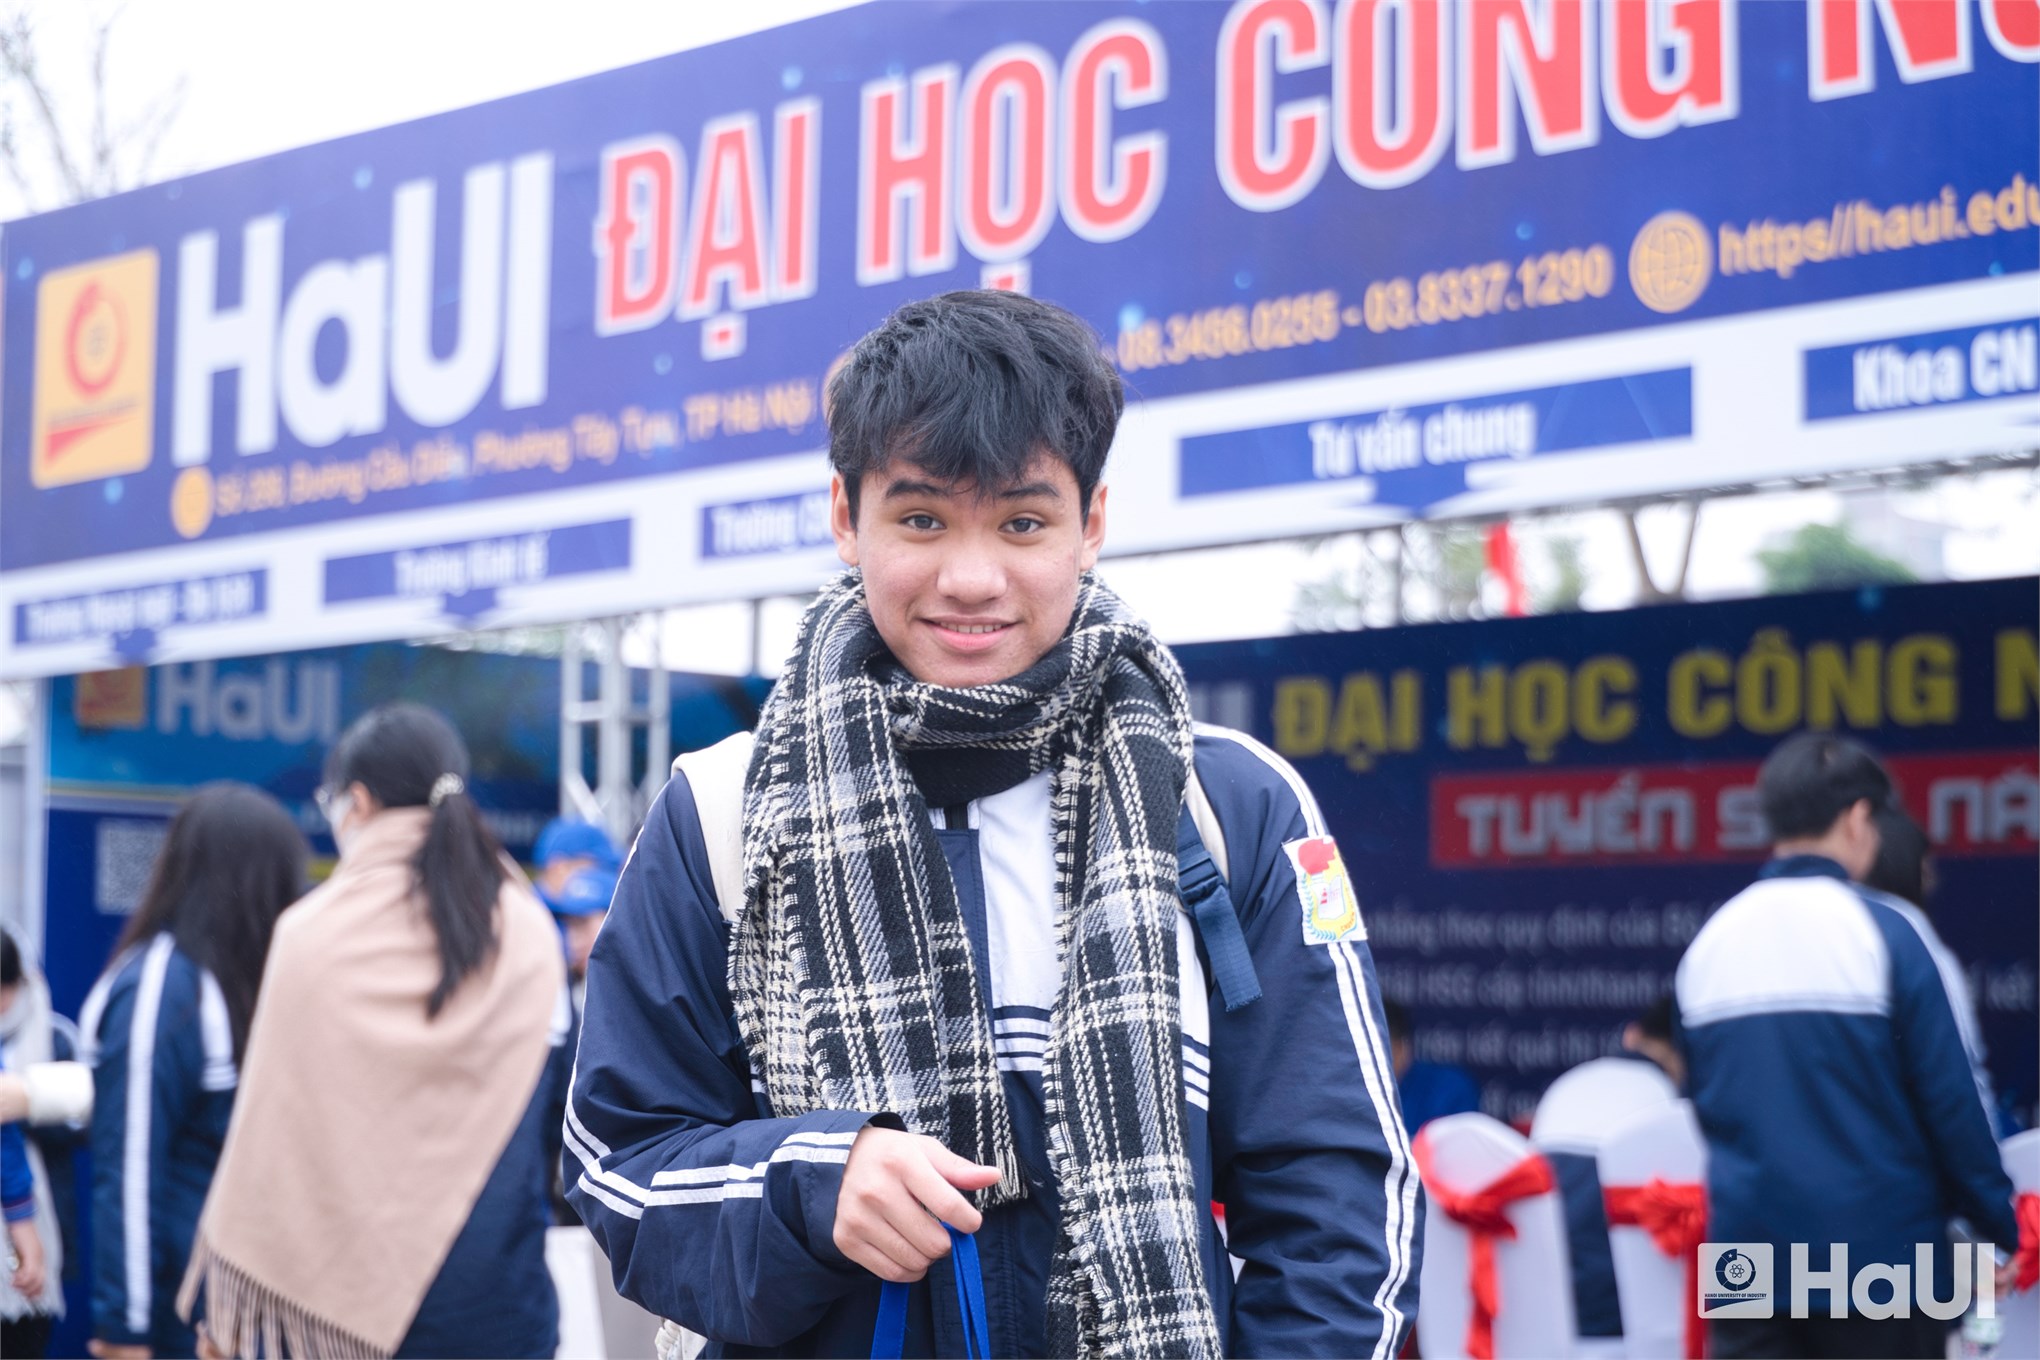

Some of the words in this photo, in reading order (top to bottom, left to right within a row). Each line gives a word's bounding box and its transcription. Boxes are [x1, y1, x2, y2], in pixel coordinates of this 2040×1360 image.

[594, 97, 822, 361] ĐẠI
[855, 17, 1169, 295] HỌC
[171, 150, 556, 468] HaUI
[1423, 402, 1537, 466] chung
[1853, 345, 1966, 411] Khoa
[156, 660, 342, 746] HaUI
[1273, 668, 1424, 771] ĐẠI
[1446, 655, 1639, 763] HỌC
[1665, 627, 1960, 738] CÔNG
